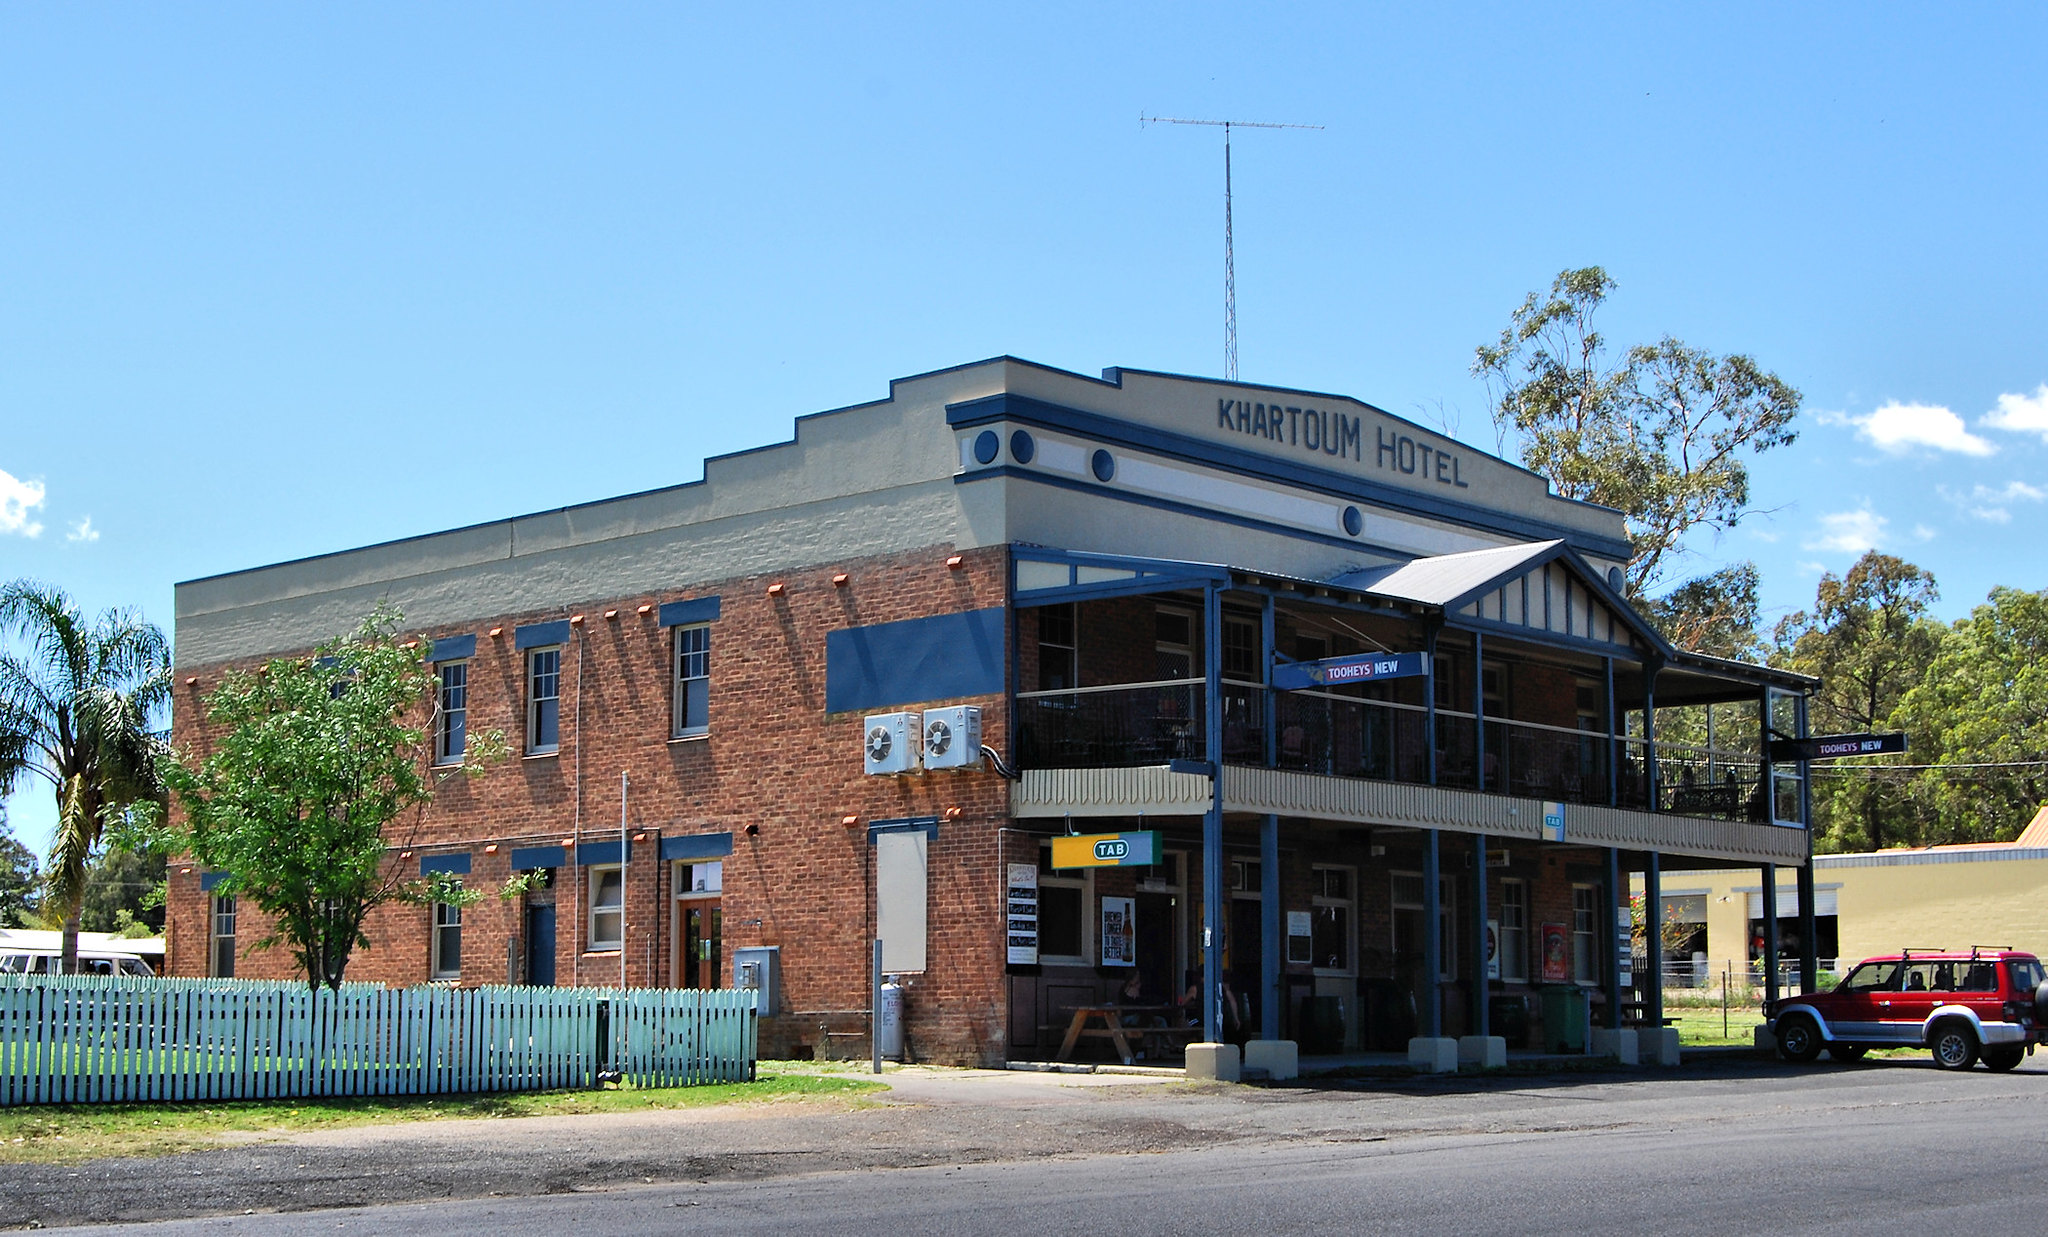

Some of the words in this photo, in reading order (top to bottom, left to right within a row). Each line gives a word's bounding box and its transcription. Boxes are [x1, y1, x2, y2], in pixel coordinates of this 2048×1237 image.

[1217, 398, 1361, 463] KHARTOUM
[1377, 425, 1469, 489] HOTEL
[1328, 664, 1371, 679] TOOHEYS
[1374, 660, 1398, 675] NEW
[1820, 742, 1857, 754] TOOHEYS
[1861, 740, 1882, 751] NEW
[1099, 844, 1124, 856] TAB
